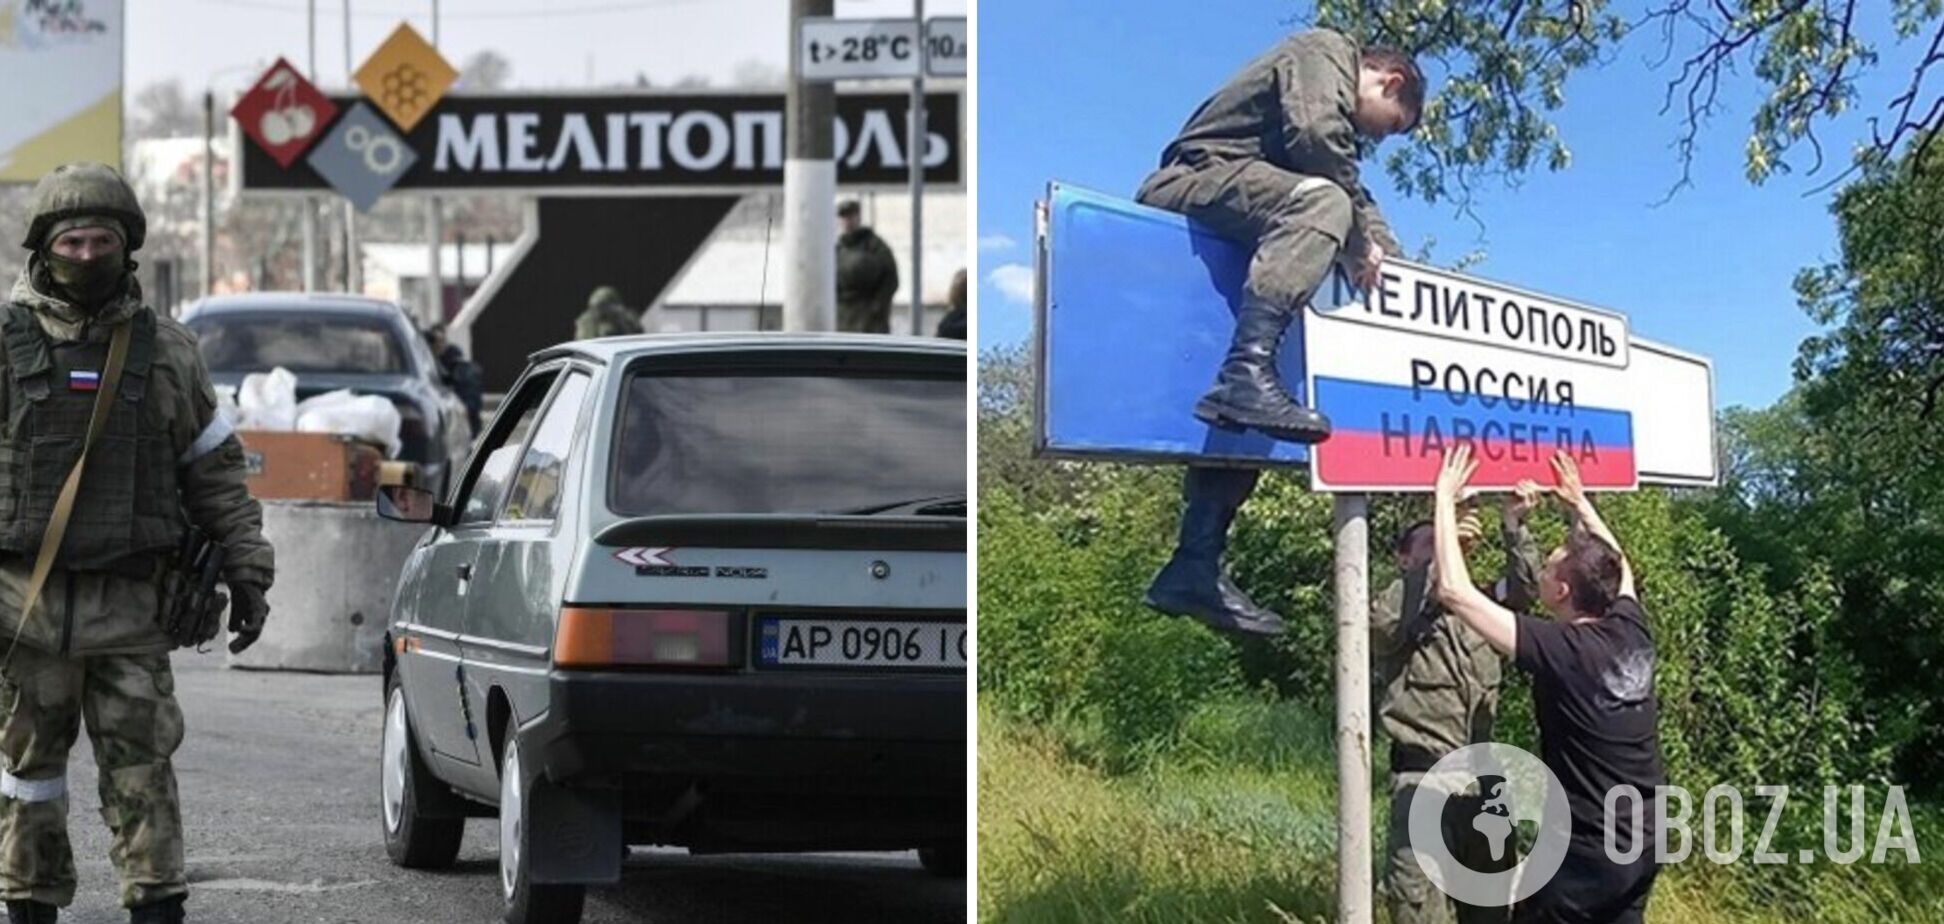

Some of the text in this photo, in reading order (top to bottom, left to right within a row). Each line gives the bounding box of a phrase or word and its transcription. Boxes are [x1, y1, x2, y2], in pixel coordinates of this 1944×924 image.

[1411, 359, 1576, 418] РОССИЯ
[782, 625, 832, 660] AP
[842, 626, 921, 661] 0906
